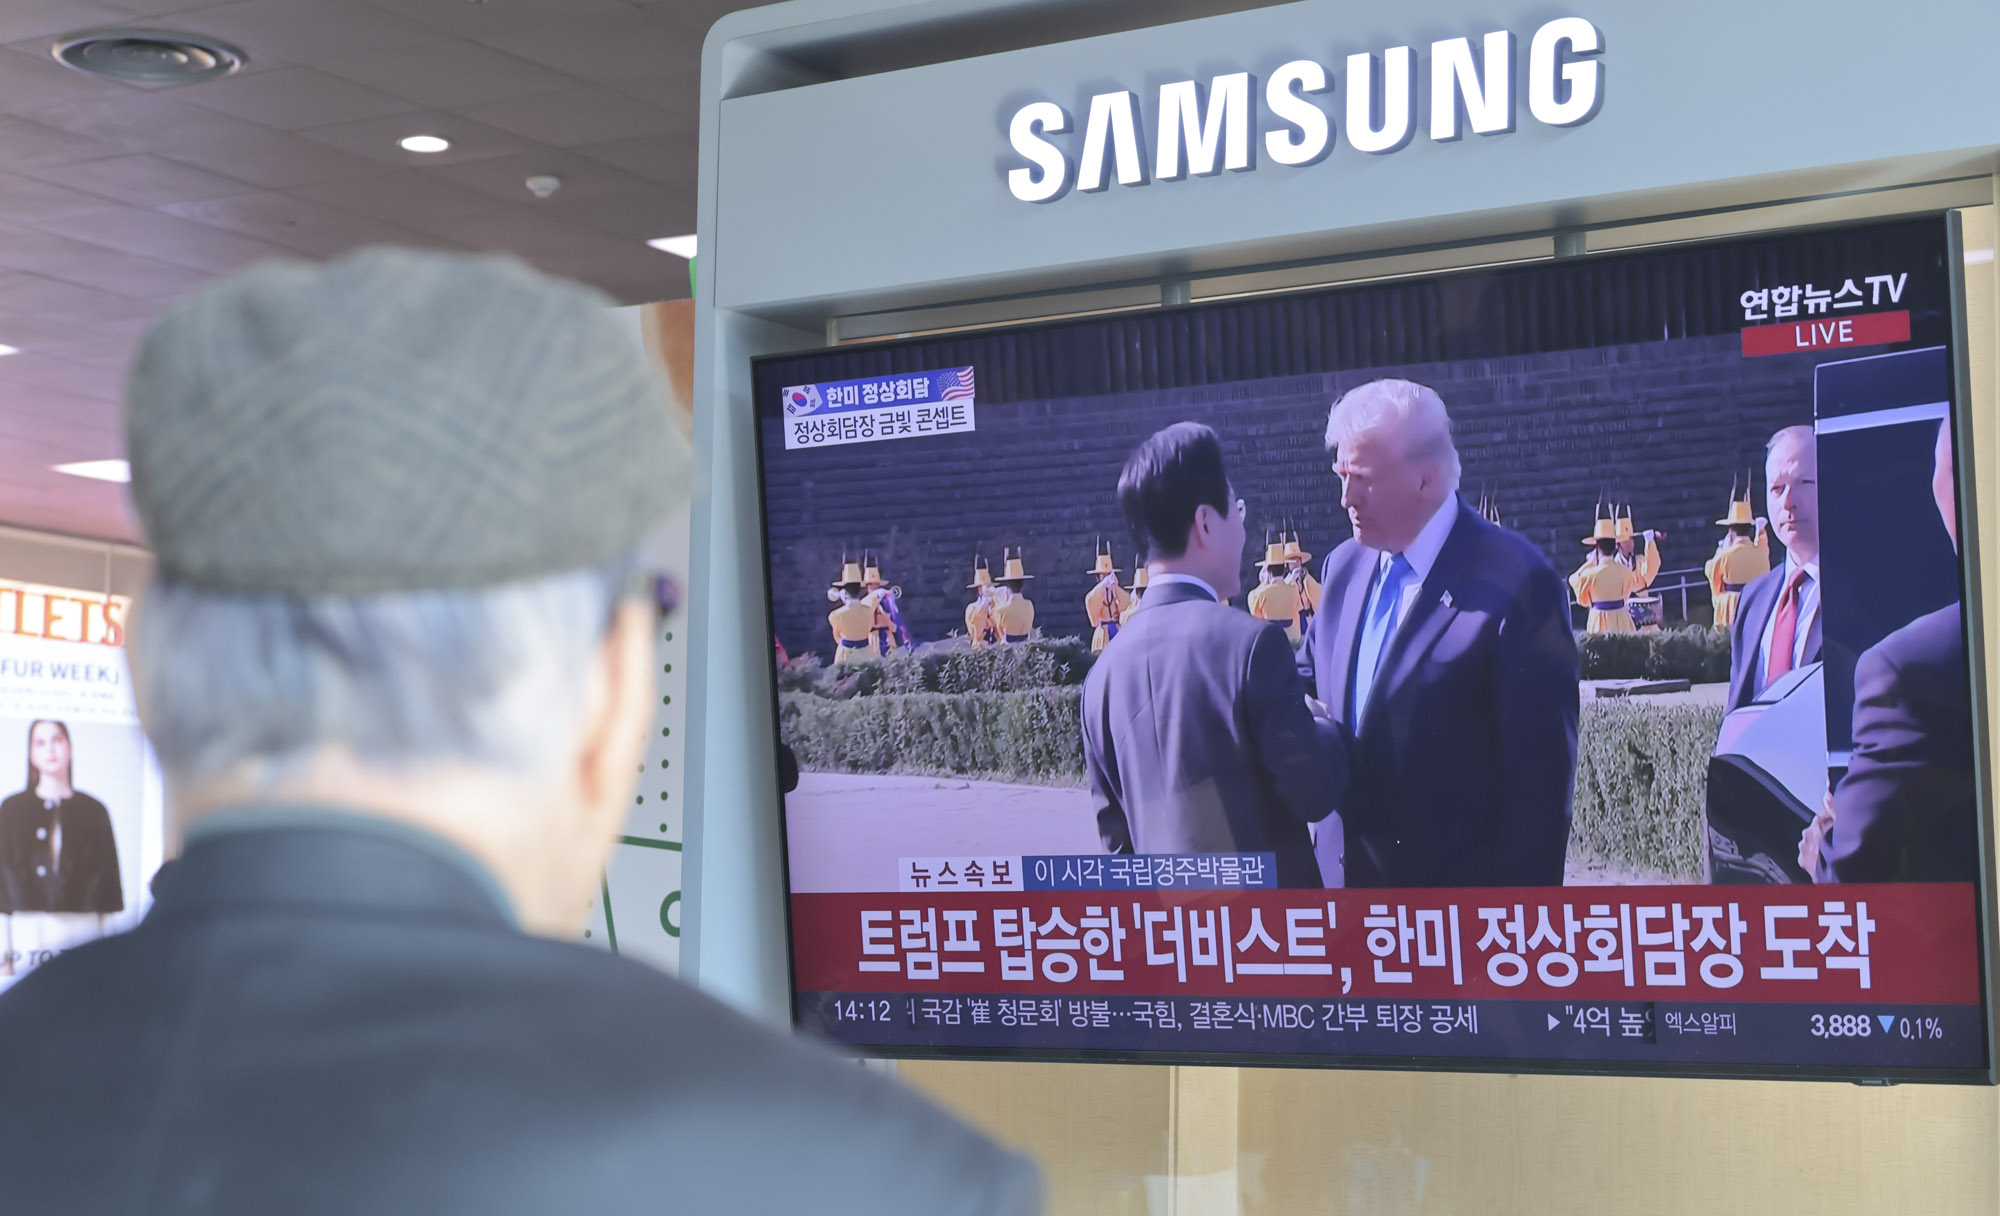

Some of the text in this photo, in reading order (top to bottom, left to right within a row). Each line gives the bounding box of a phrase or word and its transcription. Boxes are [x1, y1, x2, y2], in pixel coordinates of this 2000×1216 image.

[1008, 17, 1602, 204] SAMSUNG
[1740, 272, 1908, 321] 연합뉴스TV
[1795, 320, 1853, 347] LIVE
[826, 377, 930, 409] 한미 정상회담
[794, 404, 967, 444] 정상회담장 금빛 콘셉트
[910, 860, 1013, 888] 뉴스속보
[1034, 856, 1265, 886] 이 시각 국립경주박물관
[858, 906, 985, 980] 트럼프
[993, 905, 1126, 982] 탑승한
[1364, 904, 1463, 985] 한미
[1476, 902, 1748, 989] 정상회담장
[1760, 901, 1876, 989] 도착
[834, 1000, 891, 1022] 14:12
[921, 998, 962, 1024] 국감
[1321, 1003, 1369, 1032] 간부
[1375, 1004, 1423, 1033] 퇴장
[1429, 1004, 1479, 1034] 공세
[1665, 1012, 1943, 1040] 엑스알피 3,888 0.1%
